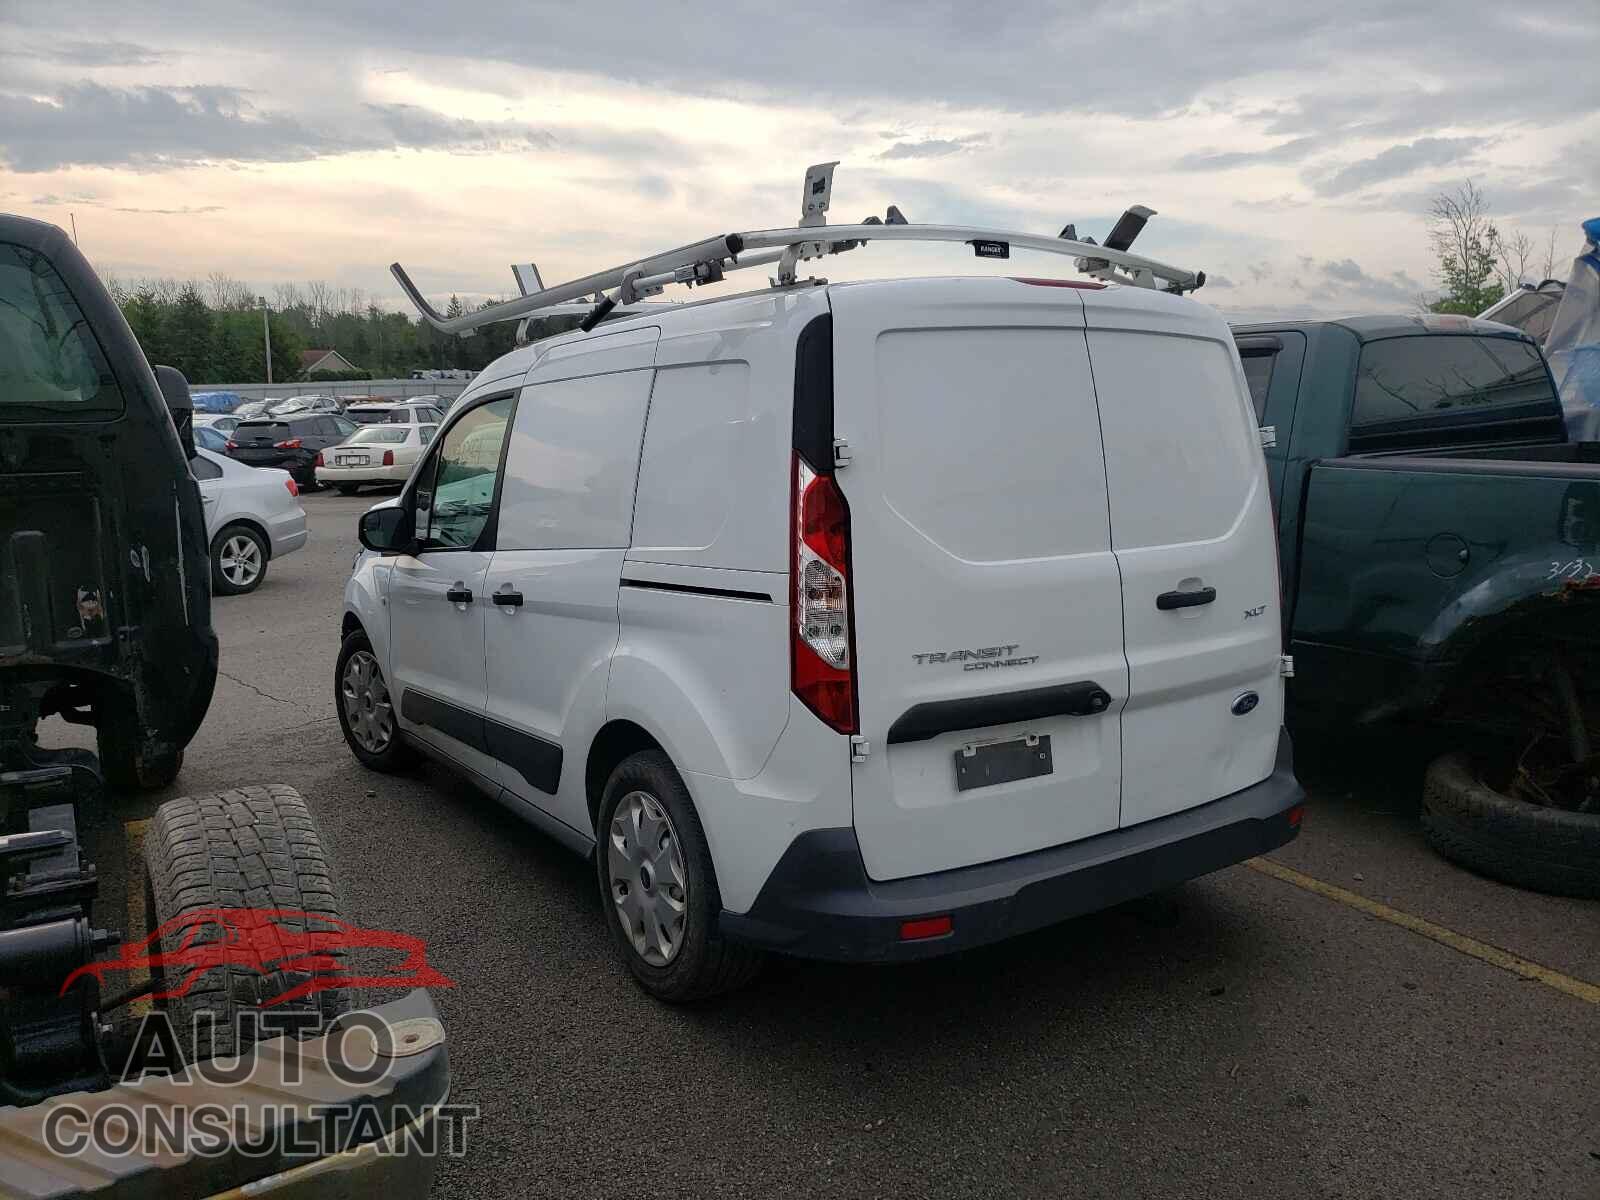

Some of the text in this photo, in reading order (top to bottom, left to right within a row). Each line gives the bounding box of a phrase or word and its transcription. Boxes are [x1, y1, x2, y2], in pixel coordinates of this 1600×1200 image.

[1244, 605, 1266, 619] XLT
[912, 644, 1019, 665] TRANSIT
[963, 655, 1039, 671] CONNECT
